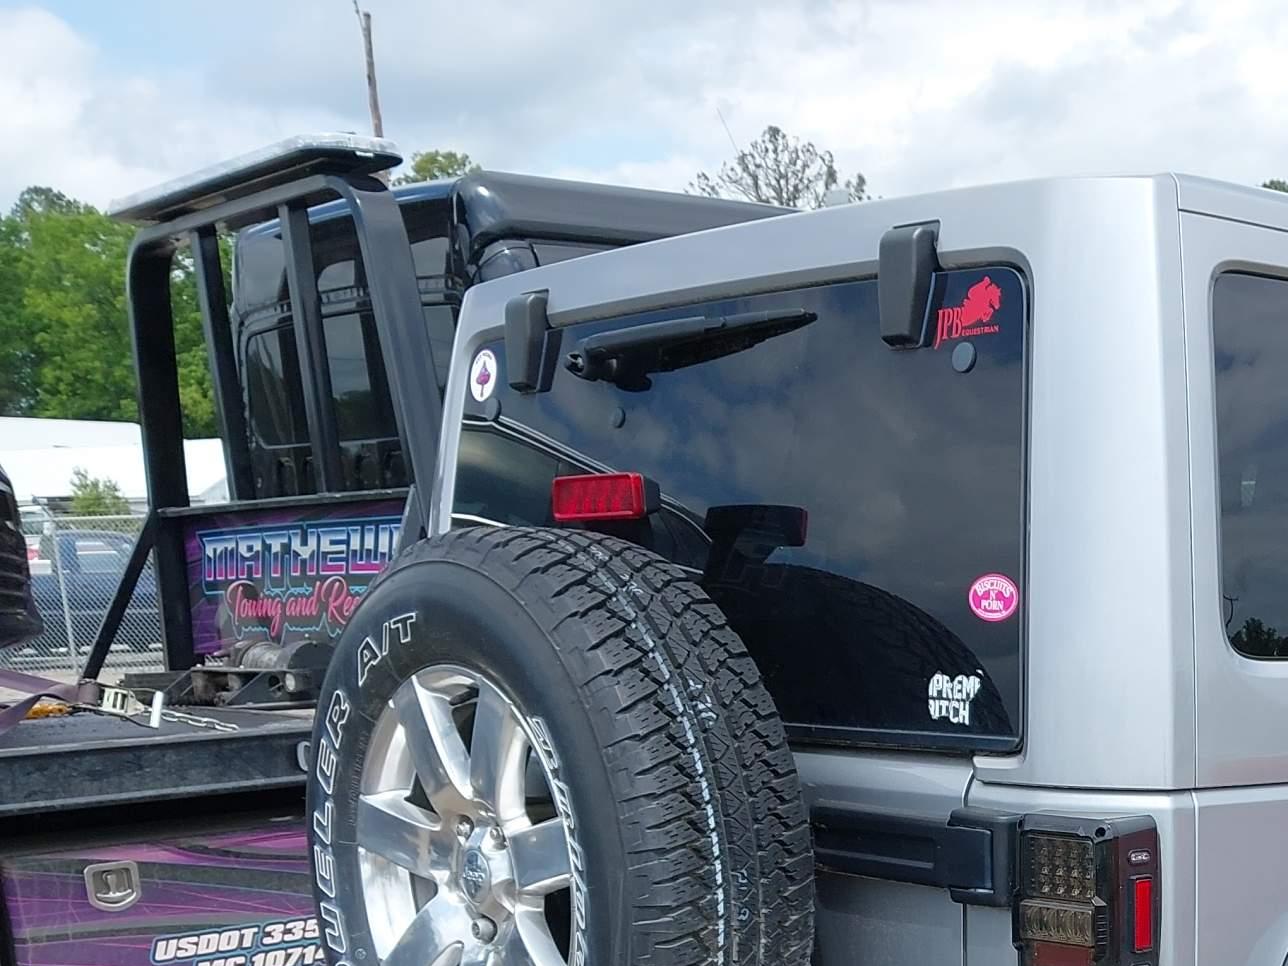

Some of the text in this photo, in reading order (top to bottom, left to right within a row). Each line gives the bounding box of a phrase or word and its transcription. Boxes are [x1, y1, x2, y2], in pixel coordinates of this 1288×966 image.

[934, 306, 999, 350] JPB EQUESTRIAN
[202, 523, 400, 581] MATHEW
[226, 579, 282, 637] Towing
[285, 581, 321, 617] and
[975, 579, 1012, 598] BISCUITS
[357, 612, 416, 687] A/T
[154, 927, 259, 962] USDOT
